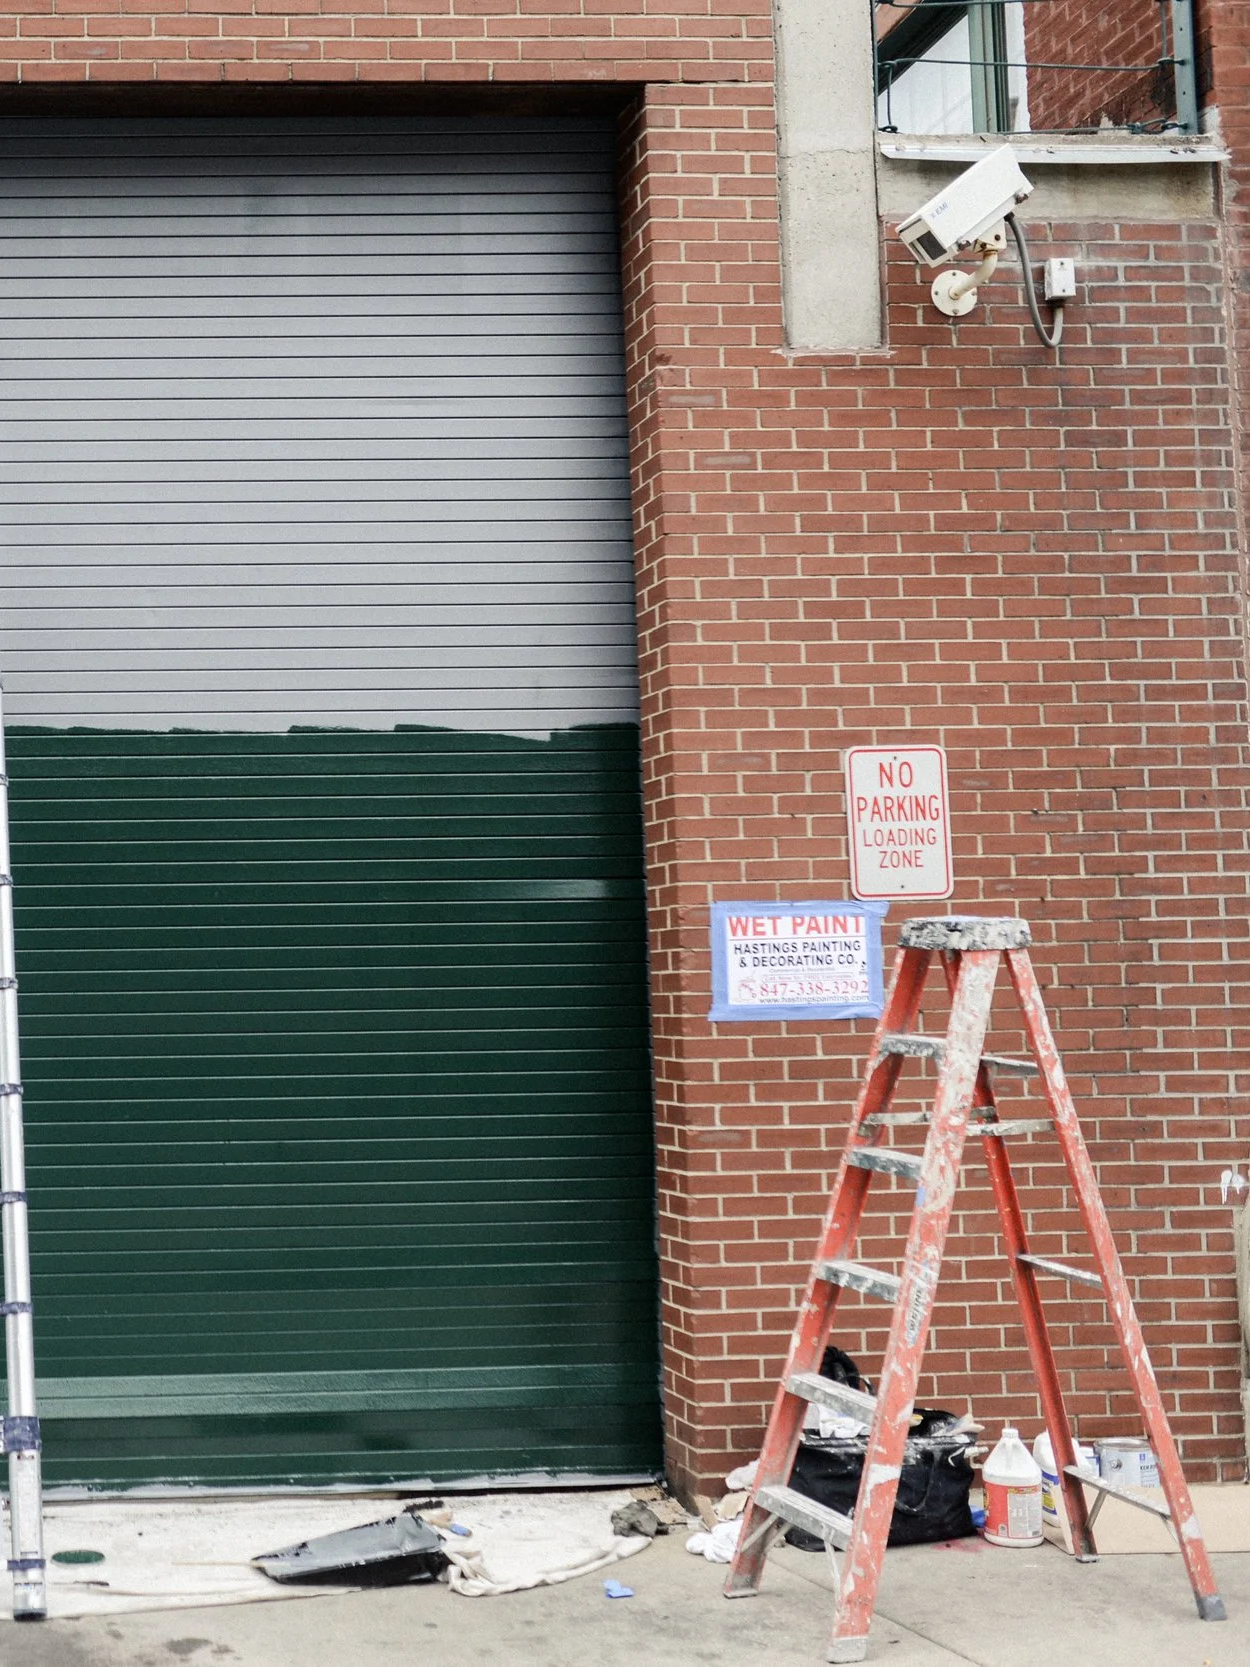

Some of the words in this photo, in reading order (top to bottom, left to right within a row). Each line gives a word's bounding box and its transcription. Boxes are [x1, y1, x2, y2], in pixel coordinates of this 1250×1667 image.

[879, 761, 913, 788] NO
[856, 795, 940, 823] PARKING
[863, 828, 937, 847] LOADING
[879, 850, 924, 868] ZONE
[728, 915, 782, 937] WET
[792, 914, 863, 935] PAINT
[734, 942, 798, 955] HASTINGS
[802, 940, 861, 953] PAINTING
[739, 957, 747, 968] &
[752, 954, 833, 967] DECORATING
[837, 954, 858, 965] CO.
[760, 980, 869, 997] 847-338-3292
